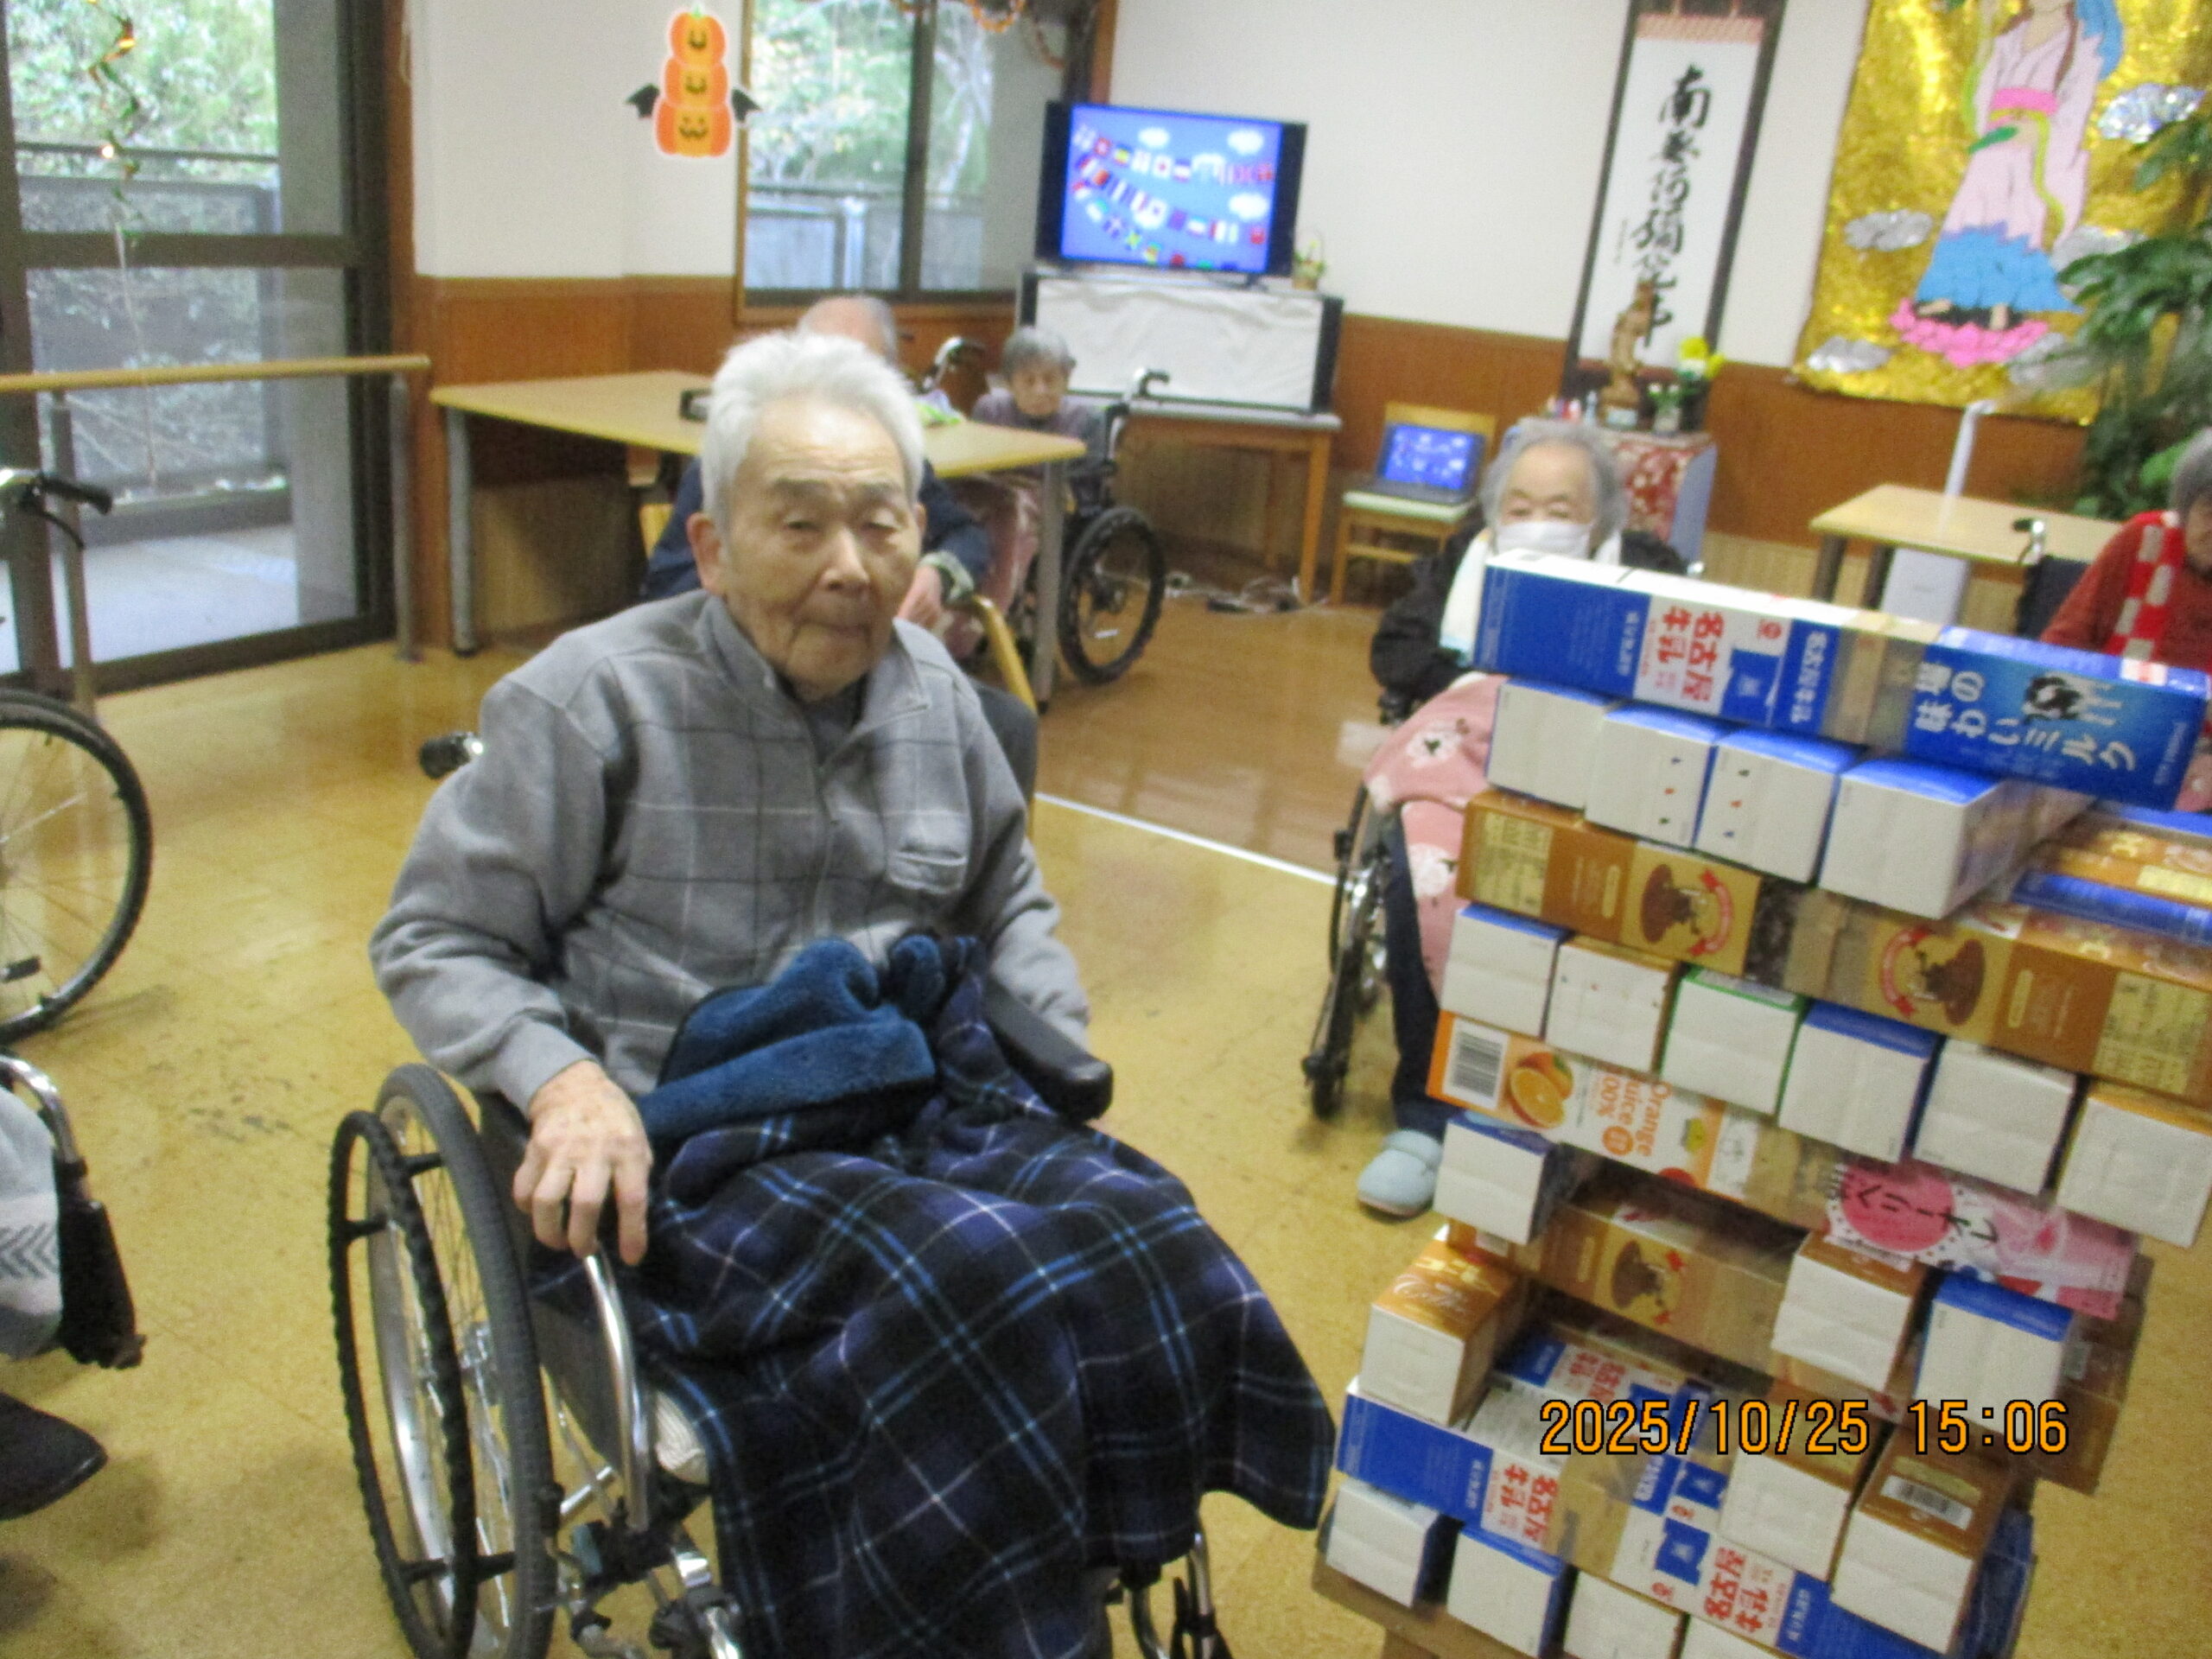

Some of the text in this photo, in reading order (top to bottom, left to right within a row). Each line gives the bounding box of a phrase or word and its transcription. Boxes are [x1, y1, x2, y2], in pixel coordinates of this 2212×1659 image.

[1657, 605, 1693, 664] 牛乳
[1681, 611, 1725, 702] 名古屋
[1913, 699, 2136, 772] 味わいミルク
[1597, 1073, 1620, 1117] 00%
[1617, 1077, 1641, 1126] uice
[1635, 1079, 1673, 1157] Orange
[1703, 1546, 1746, 1620] 名古屋
